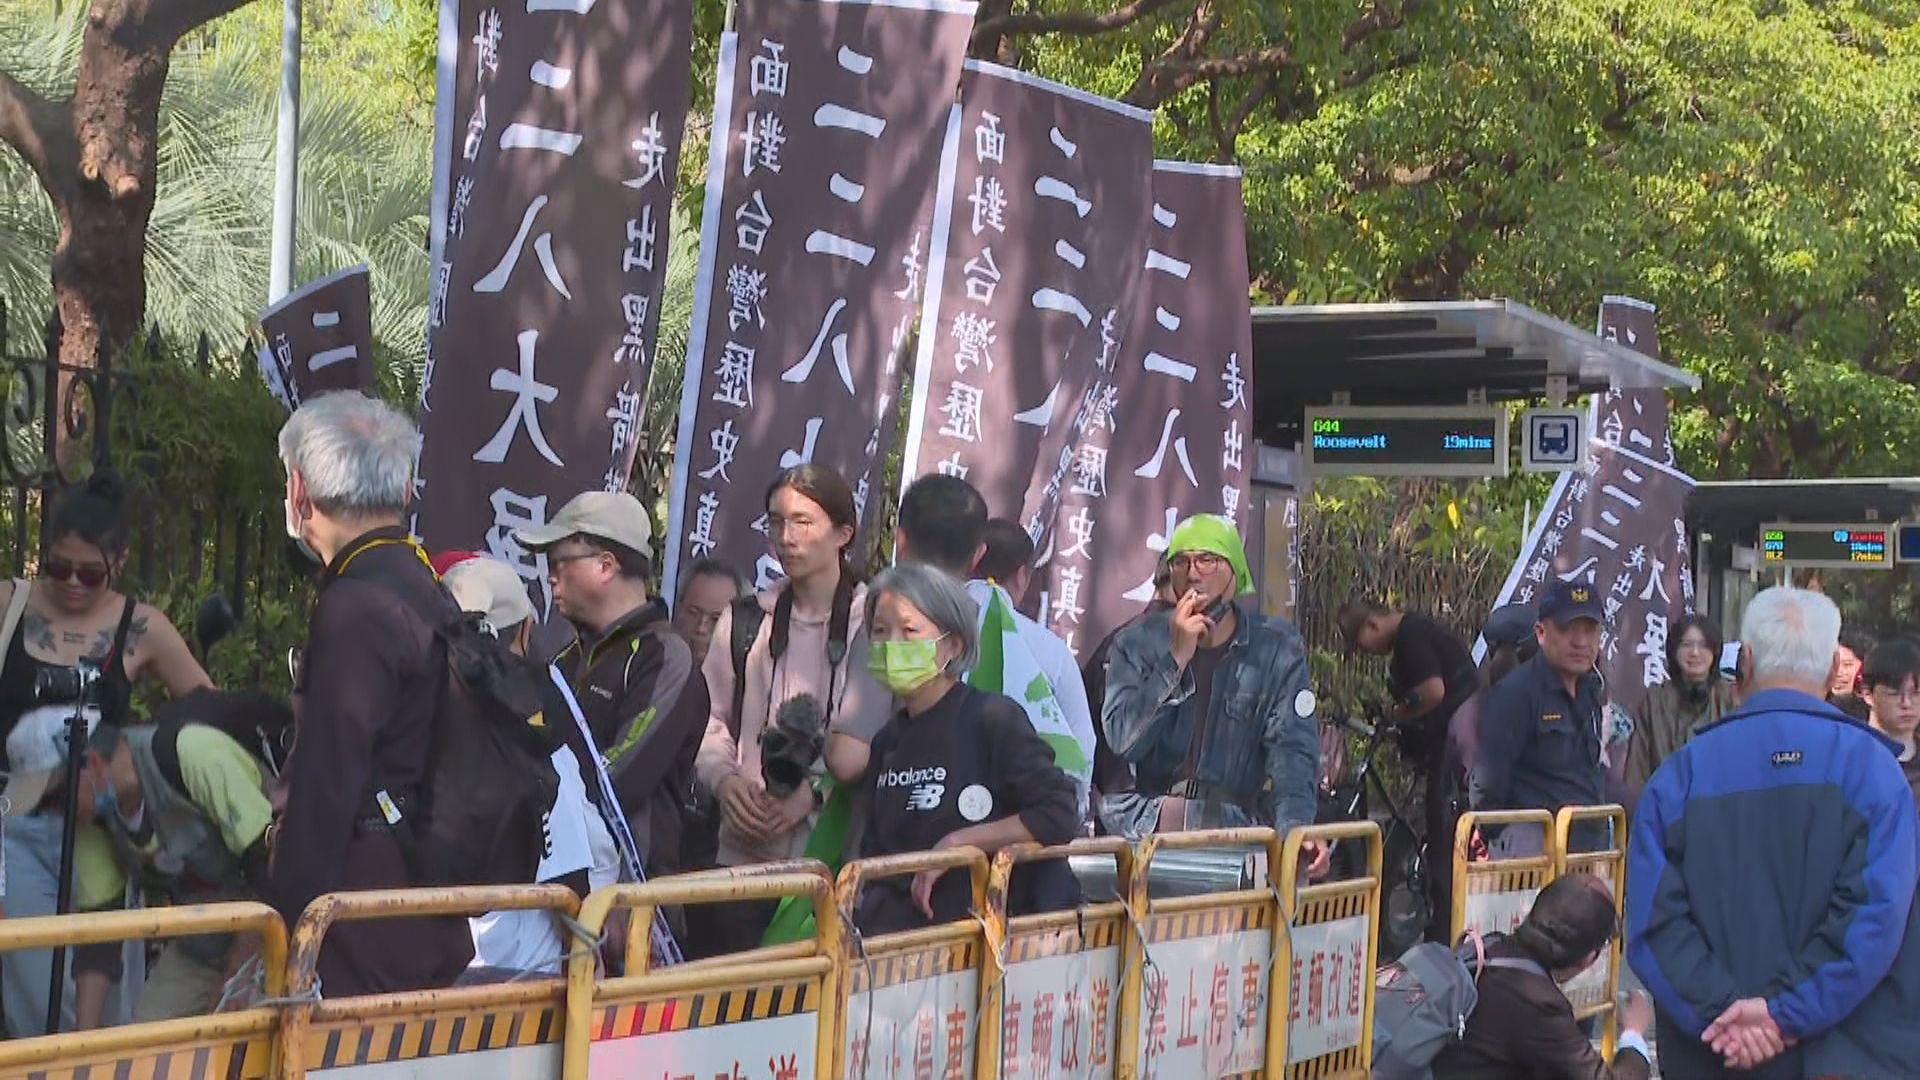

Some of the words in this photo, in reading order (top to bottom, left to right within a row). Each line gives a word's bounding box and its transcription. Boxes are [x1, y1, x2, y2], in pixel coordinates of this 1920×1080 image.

[1313, 419, 1341, 433] 644
[1313, 435, 1388, 449] Roosevelt
[1443, 435, 1493, 449] 19mins
[1144, 956, 1261, 1058] 禁止停車
[1287, 938, 1362, 1028] 車輛改道
